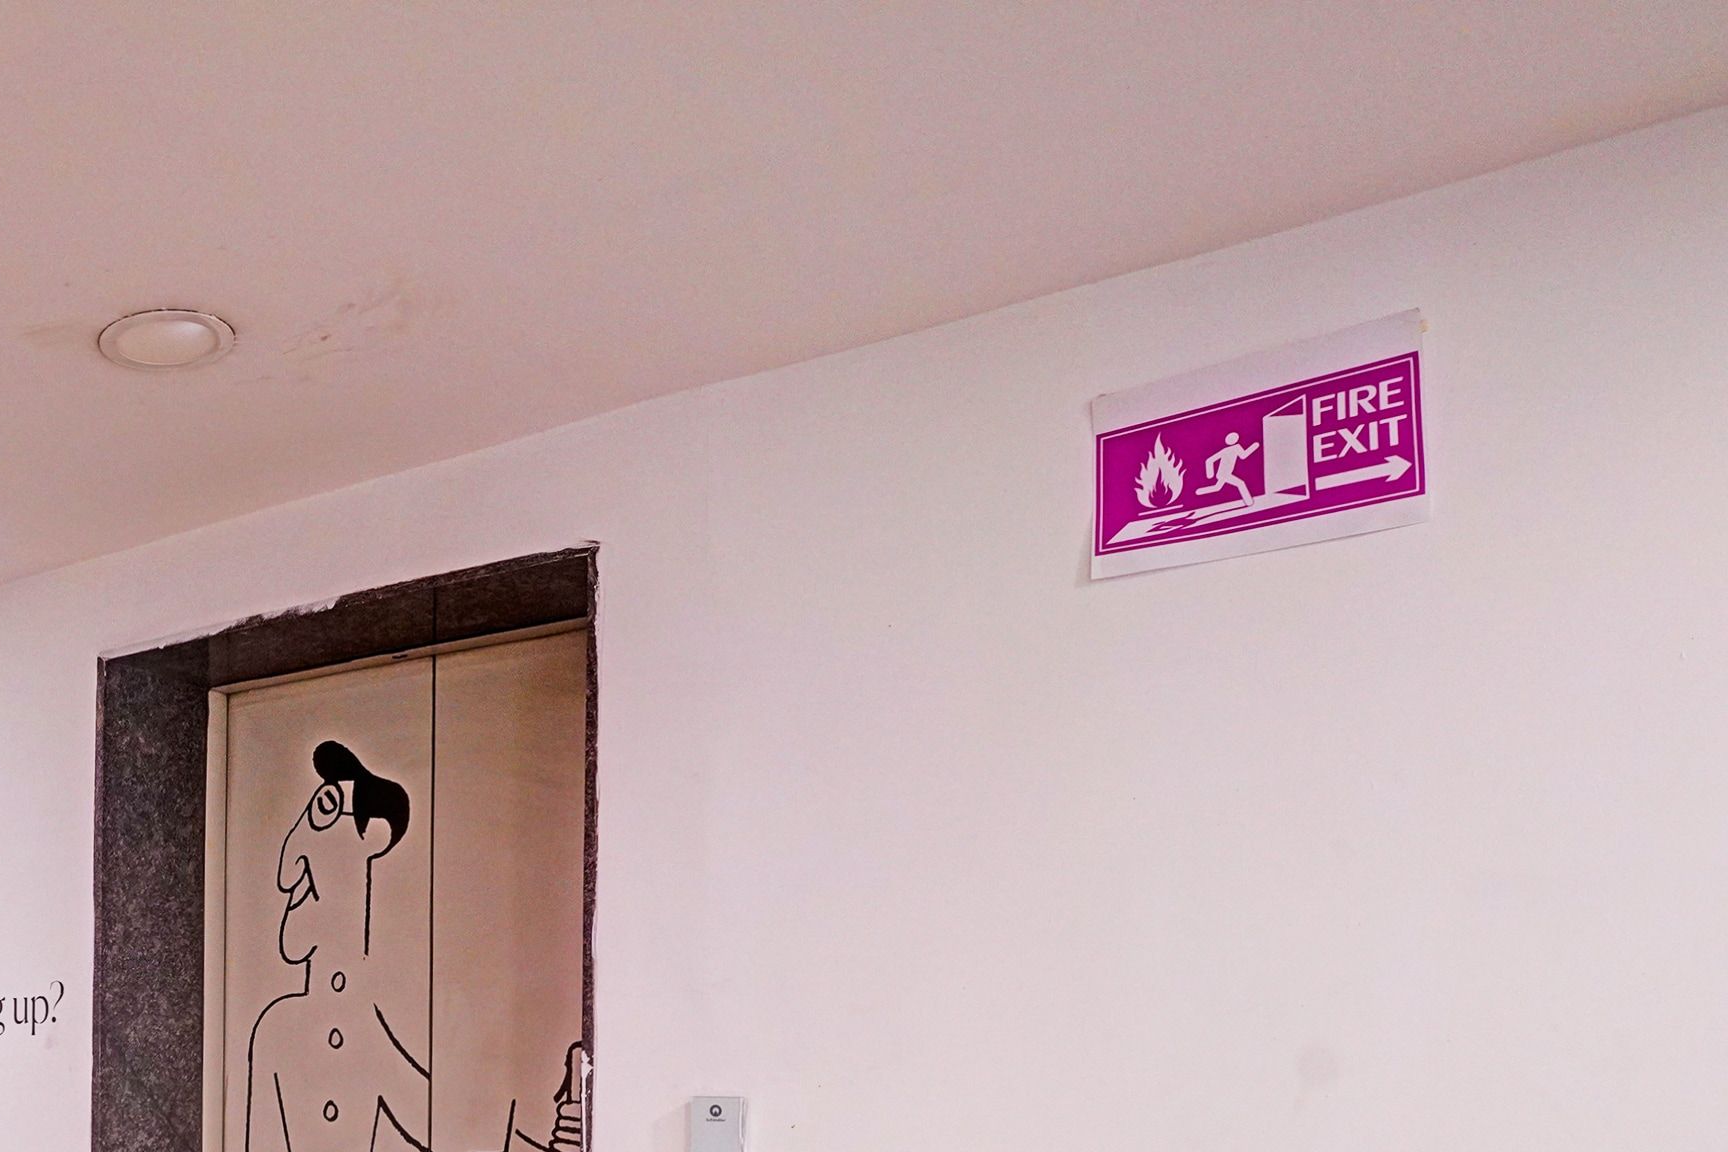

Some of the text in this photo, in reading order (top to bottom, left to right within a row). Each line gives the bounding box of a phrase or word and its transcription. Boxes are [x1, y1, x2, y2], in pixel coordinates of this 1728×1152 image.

[1312, 376, 1404, 427] FIRE
[1313, 414, 1408, 463] EXIT
[12, 980, 65, 1036] up?
